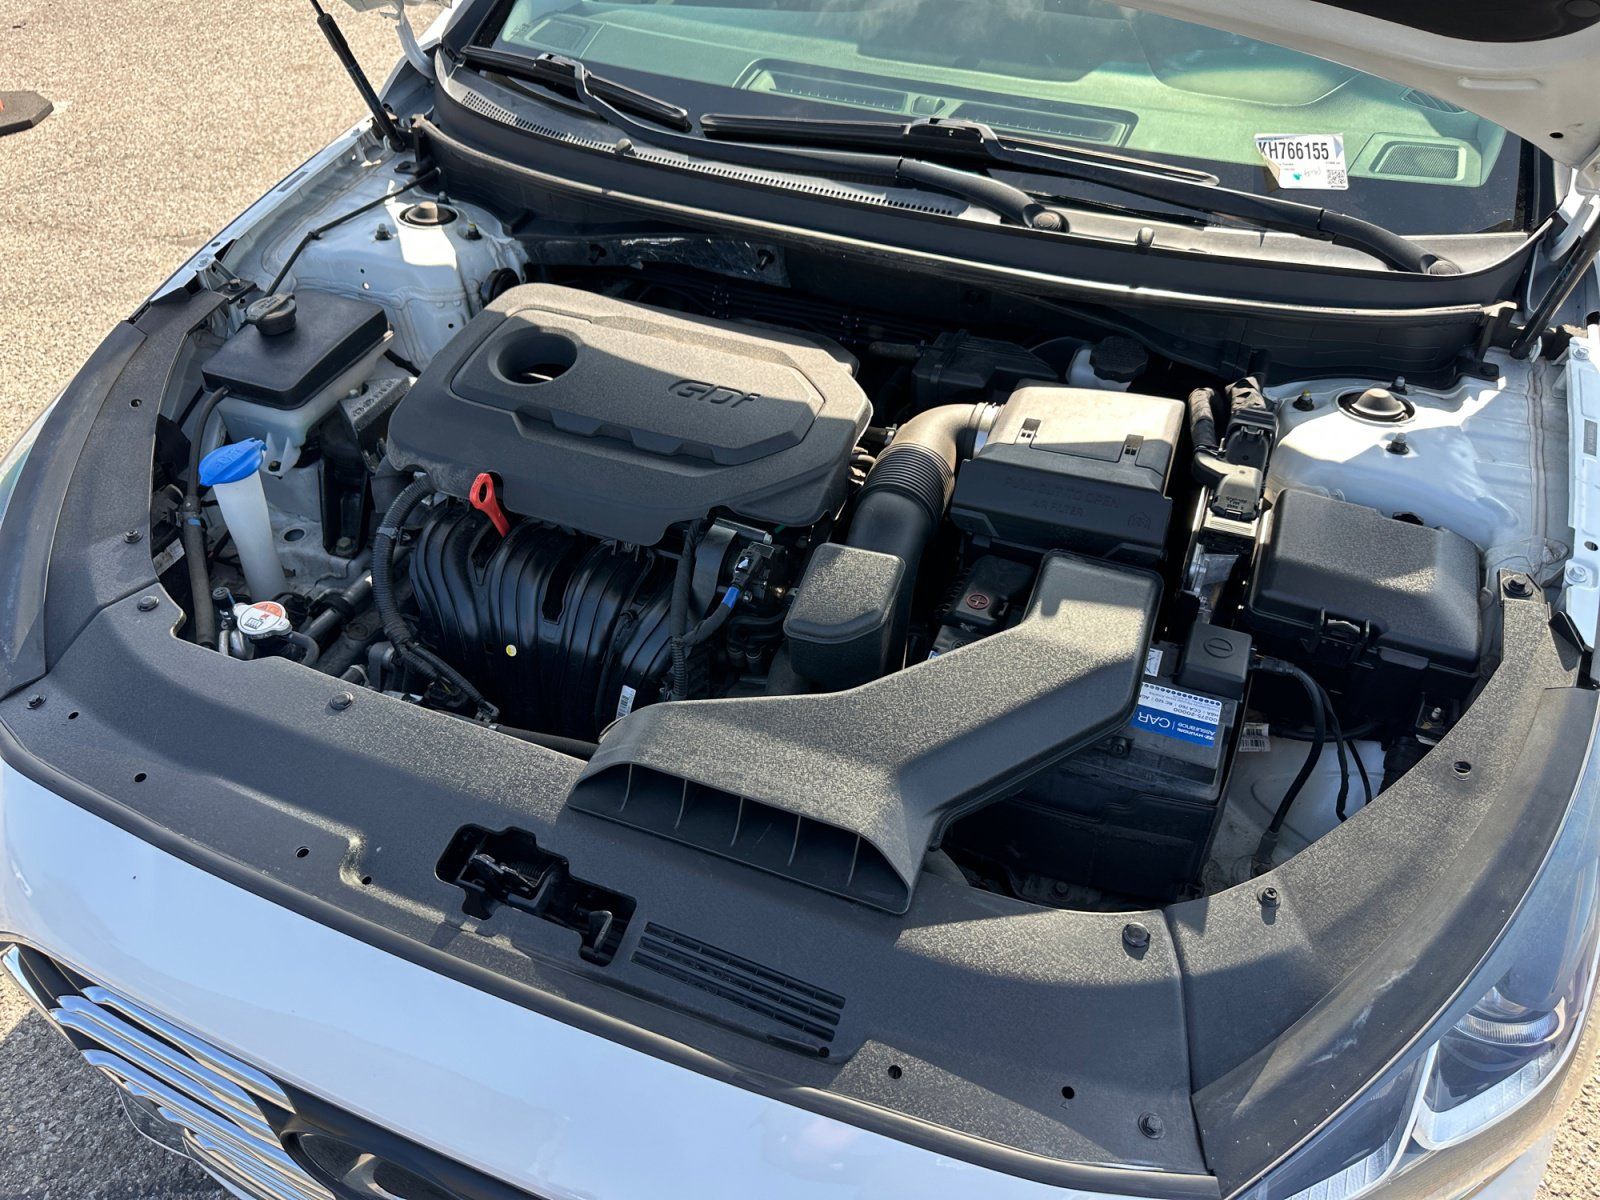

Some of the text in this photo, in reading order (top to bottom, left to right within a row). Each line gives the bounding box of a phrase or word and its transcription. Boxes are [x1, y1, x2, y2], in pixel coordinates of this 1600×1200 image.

[1258, 142, 1329, 159] KH766155
[1050, 502, 1084, 517] FILTER
[1138, 712, 1170, 728] CAR
